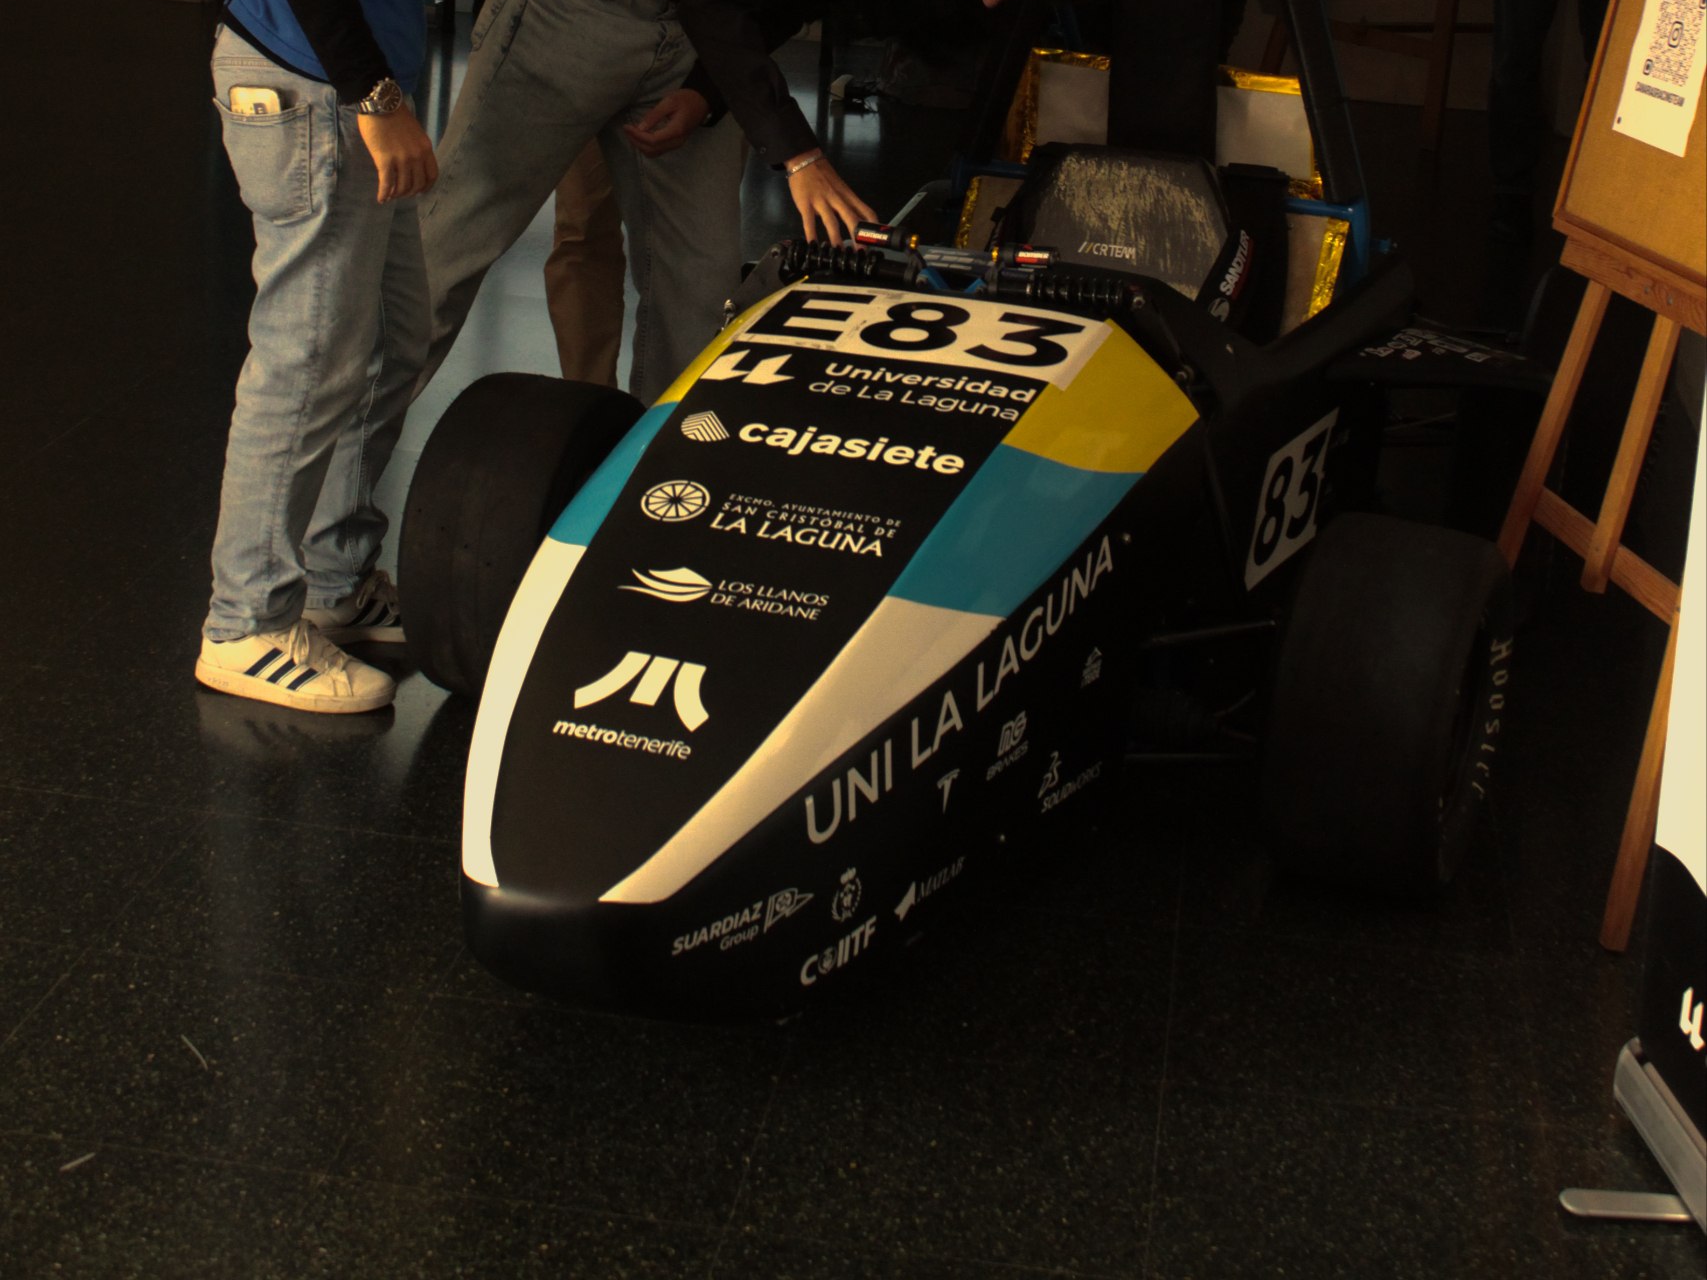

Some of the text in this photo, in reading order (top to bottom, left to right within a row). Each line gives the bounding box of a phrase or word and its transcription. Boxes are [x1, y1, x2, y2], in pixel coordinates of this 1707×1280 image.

[745, 290, 1085, 367] E83
[808, 379, 1021, 423] de La Laguna
[825, 362, 1037, 405] Universidad
[738, 422, 966, 475] cajasiete
[728, 493, 902, 528] EXCMO. AYUNTAMIENTO DE
[1254, 427, 1329, 566] 83
[709, 511, 884, 558] LA LAGUNA
[721, 501, 758, 516] SAN
[873, 527, 897, 539] DE
[709, 592, 821, 621] DE ARIDANE
[718, 580, 830, 607] LOS LLANOS
[804, 534, 1115, 845] UNI LA LAGUNA
[552, 719, 692, 761] metrotenerife
[671, 901, 764, 957] SUARDIAZ
[719, 924, 760, 952] Group
